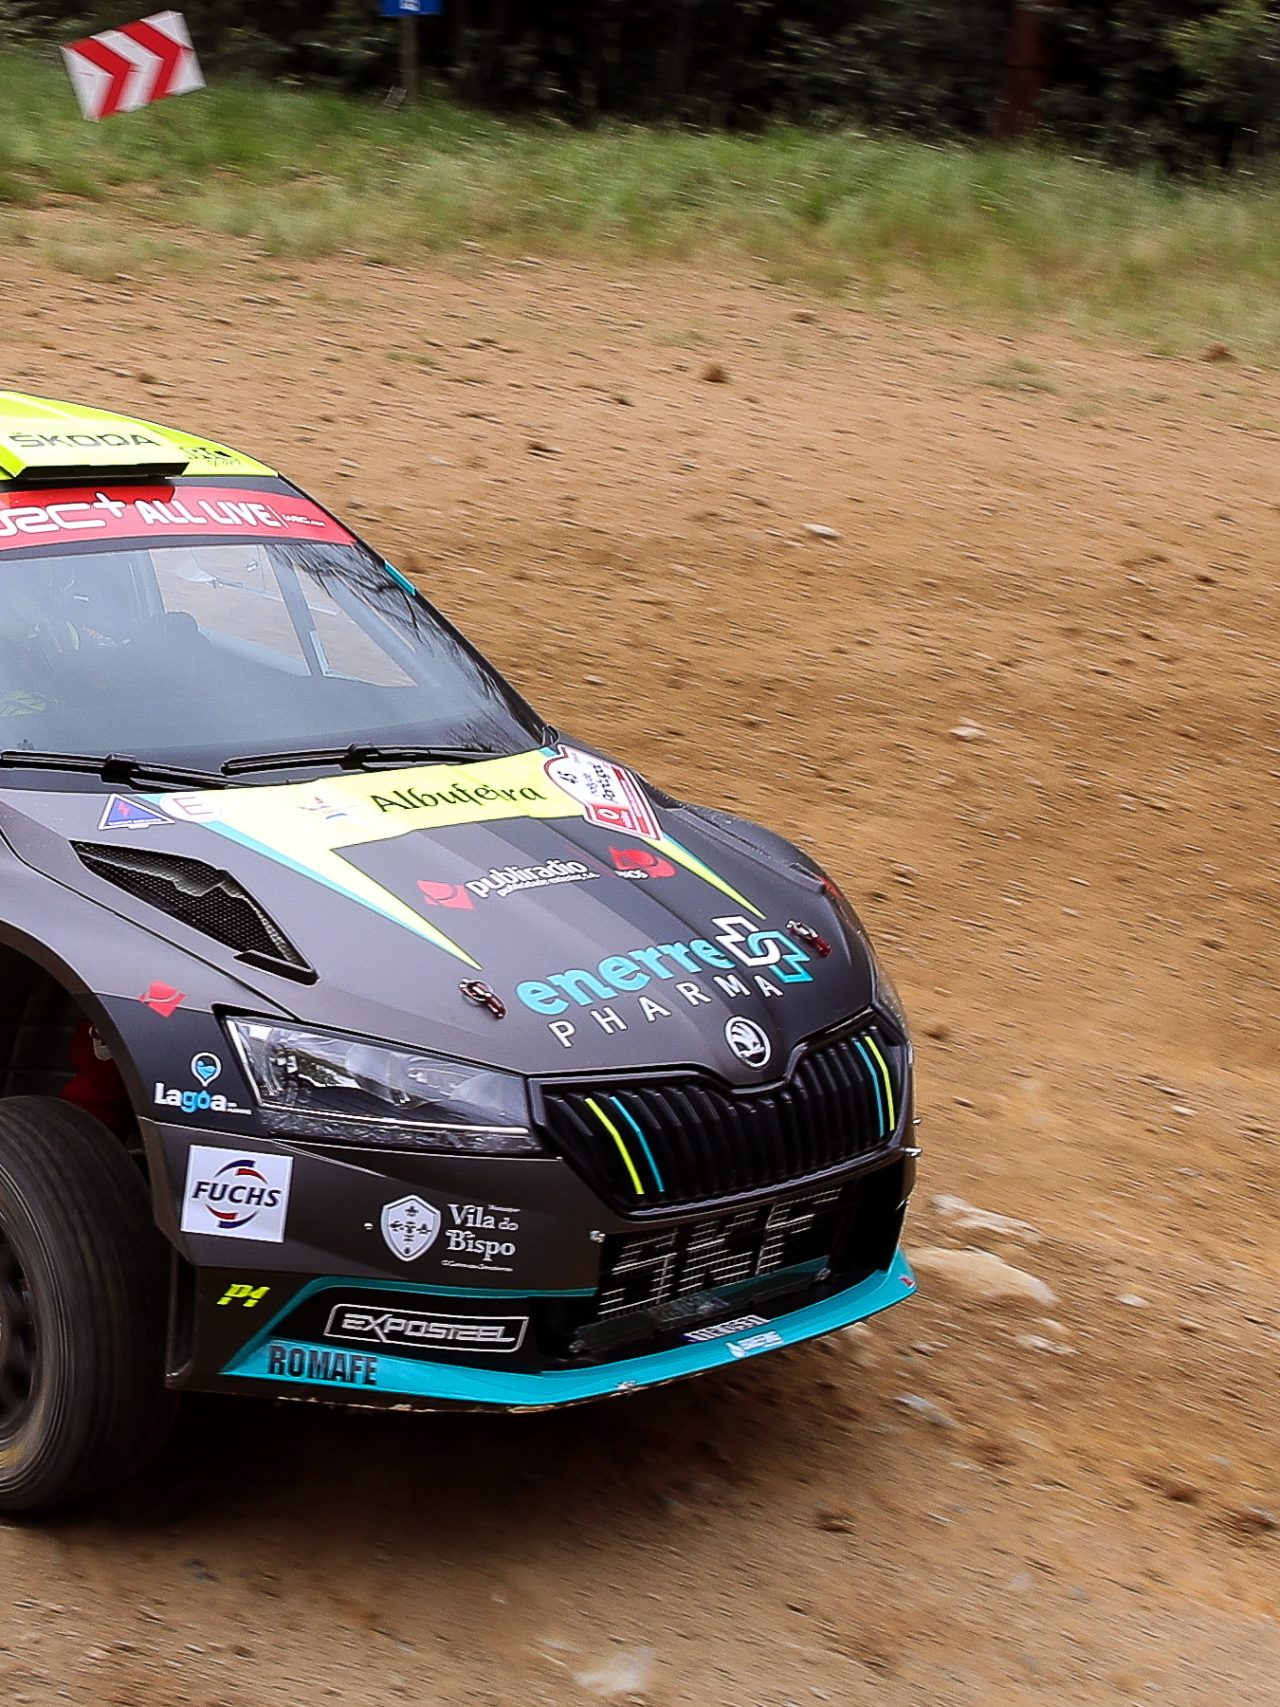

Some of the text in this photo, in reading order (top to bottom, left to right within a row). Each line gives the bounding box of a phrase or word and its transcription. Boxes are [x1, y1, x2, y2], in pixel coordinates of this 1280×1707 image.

[9, 432, 162, 447] ŠKODA
[135, 499, 208, 525] ALL
[199, 500, 281, 528] LIVE
[370, 782, 547, 813] Albufeira
[465, 858, 589, 898] publiradio
[516, 938, 737, 1016] enerre
[191, 1180, 282, 1208] FUCHS
[446, 1203, 496, 1229] Vila
[497, 1217, 519, 1231] do
[445, 1229, 516, 1262] Bispo
[341, 1313, 516, 1343] EXPOSTEEL
[267, 1344, 379, 1386] ROMAFE
